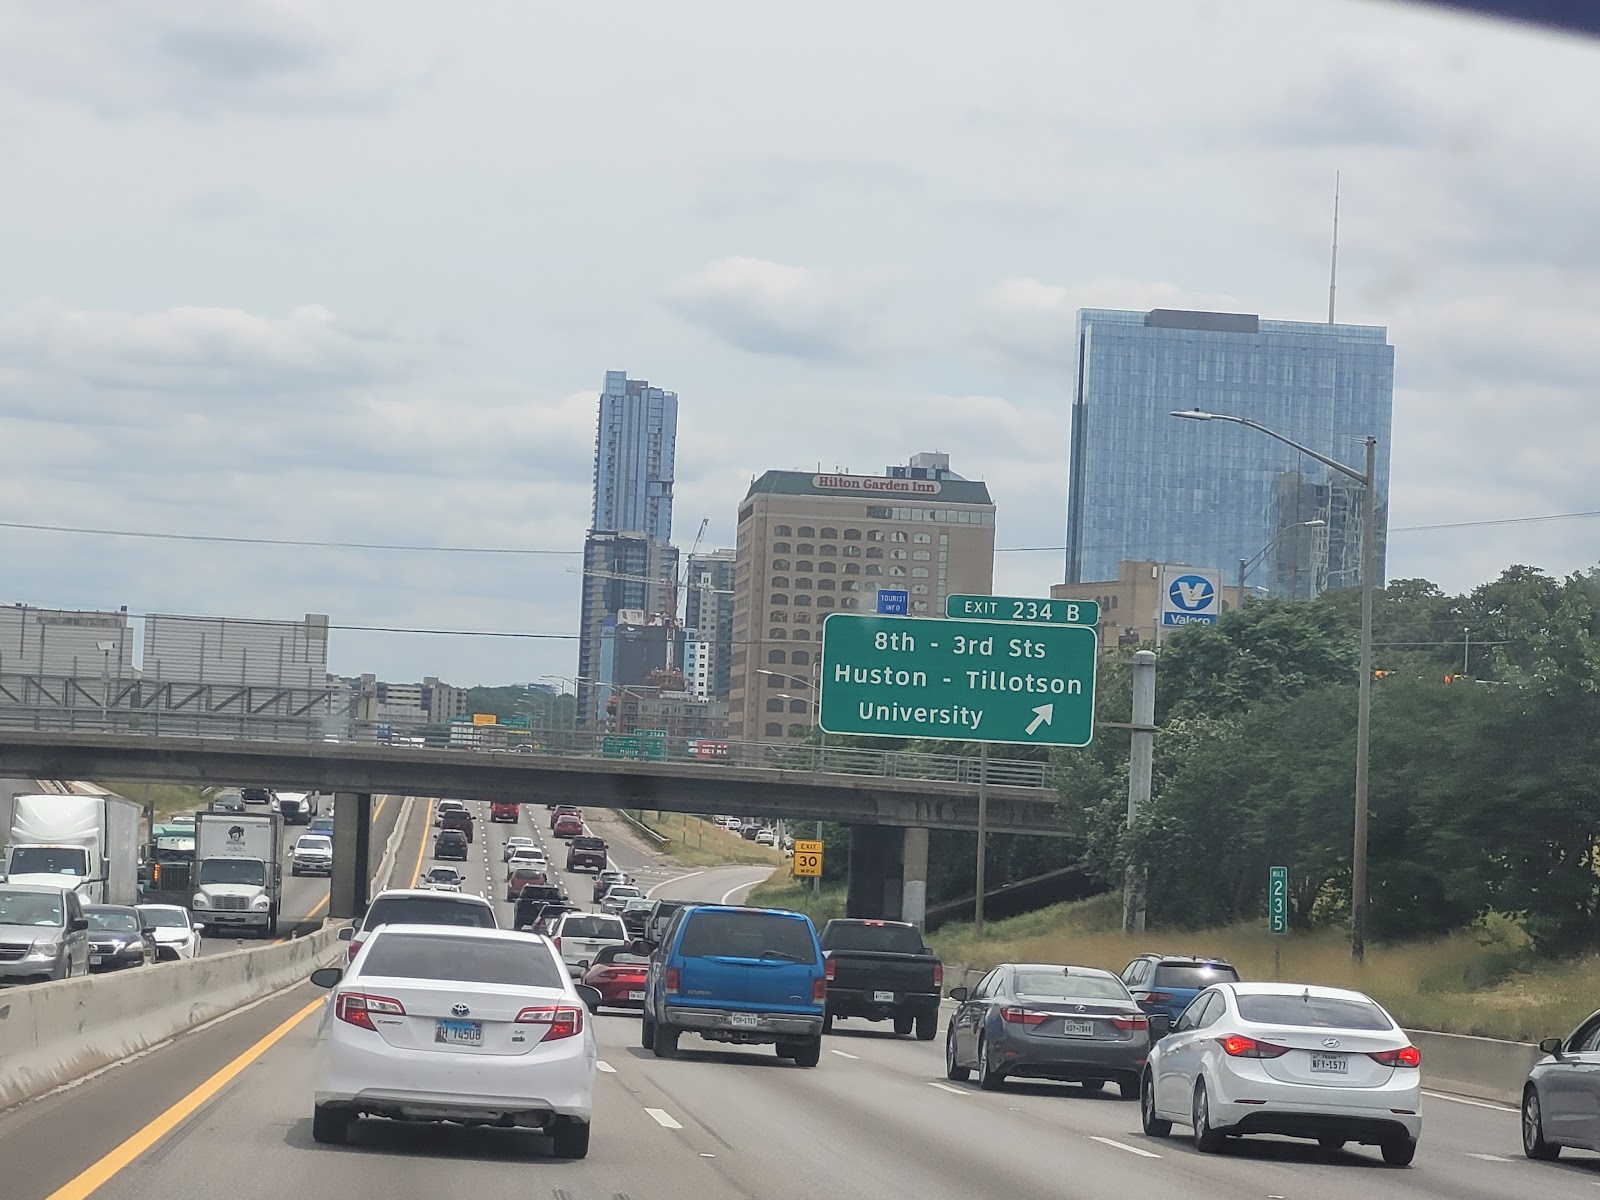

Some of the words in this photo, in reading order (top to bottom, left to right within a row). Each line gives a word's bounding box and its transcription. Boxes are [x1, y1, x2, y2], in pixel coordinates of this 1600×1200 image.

[818, 476, 860, 489] Hilton
[863, 479, 909, 491] Garden
[912, 481, 935, 492] Inn
[881, 595, 906, 603] TOURIST
[885, 604, 901, 612] INFO
[964, 601, 998, 614] EXIT
[1012, 601, 1052, 620] 234
[1067, 604, 1080, 622] B
[874, 631, 915, 652] 8th
[953, 635, 993, 656] 3rd
[1008, 638, 1046, 659] Sts
[835, 664, 927, 687] Huston
[966, 670, 1081, 695] Tillotson
[859, 702, 983, 730] University
[799, 856, 817, 867] 30
